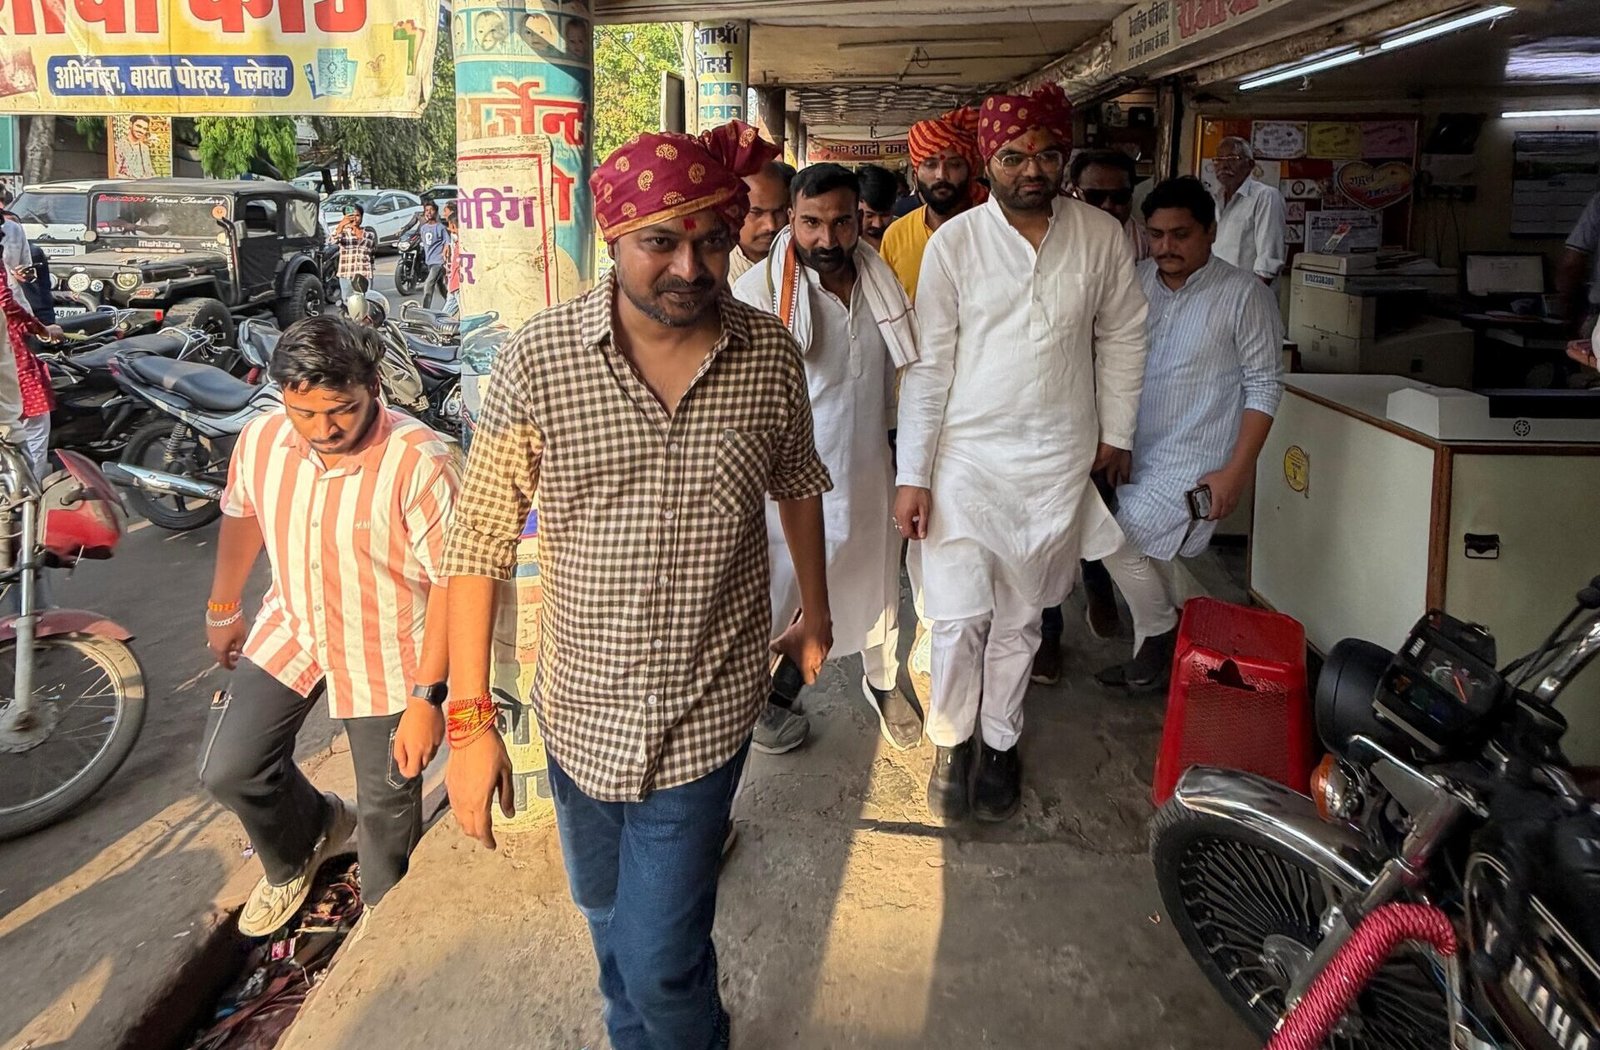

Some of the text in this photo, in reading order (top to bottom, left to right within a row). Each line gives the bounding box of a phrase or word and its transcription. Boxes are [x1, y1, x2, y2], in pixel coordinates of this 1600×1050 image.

[130, 66, 173, 89] बारात
[174, 58, 230, 94] पोस्टर,
[851, 141, 881, 155] शादी
